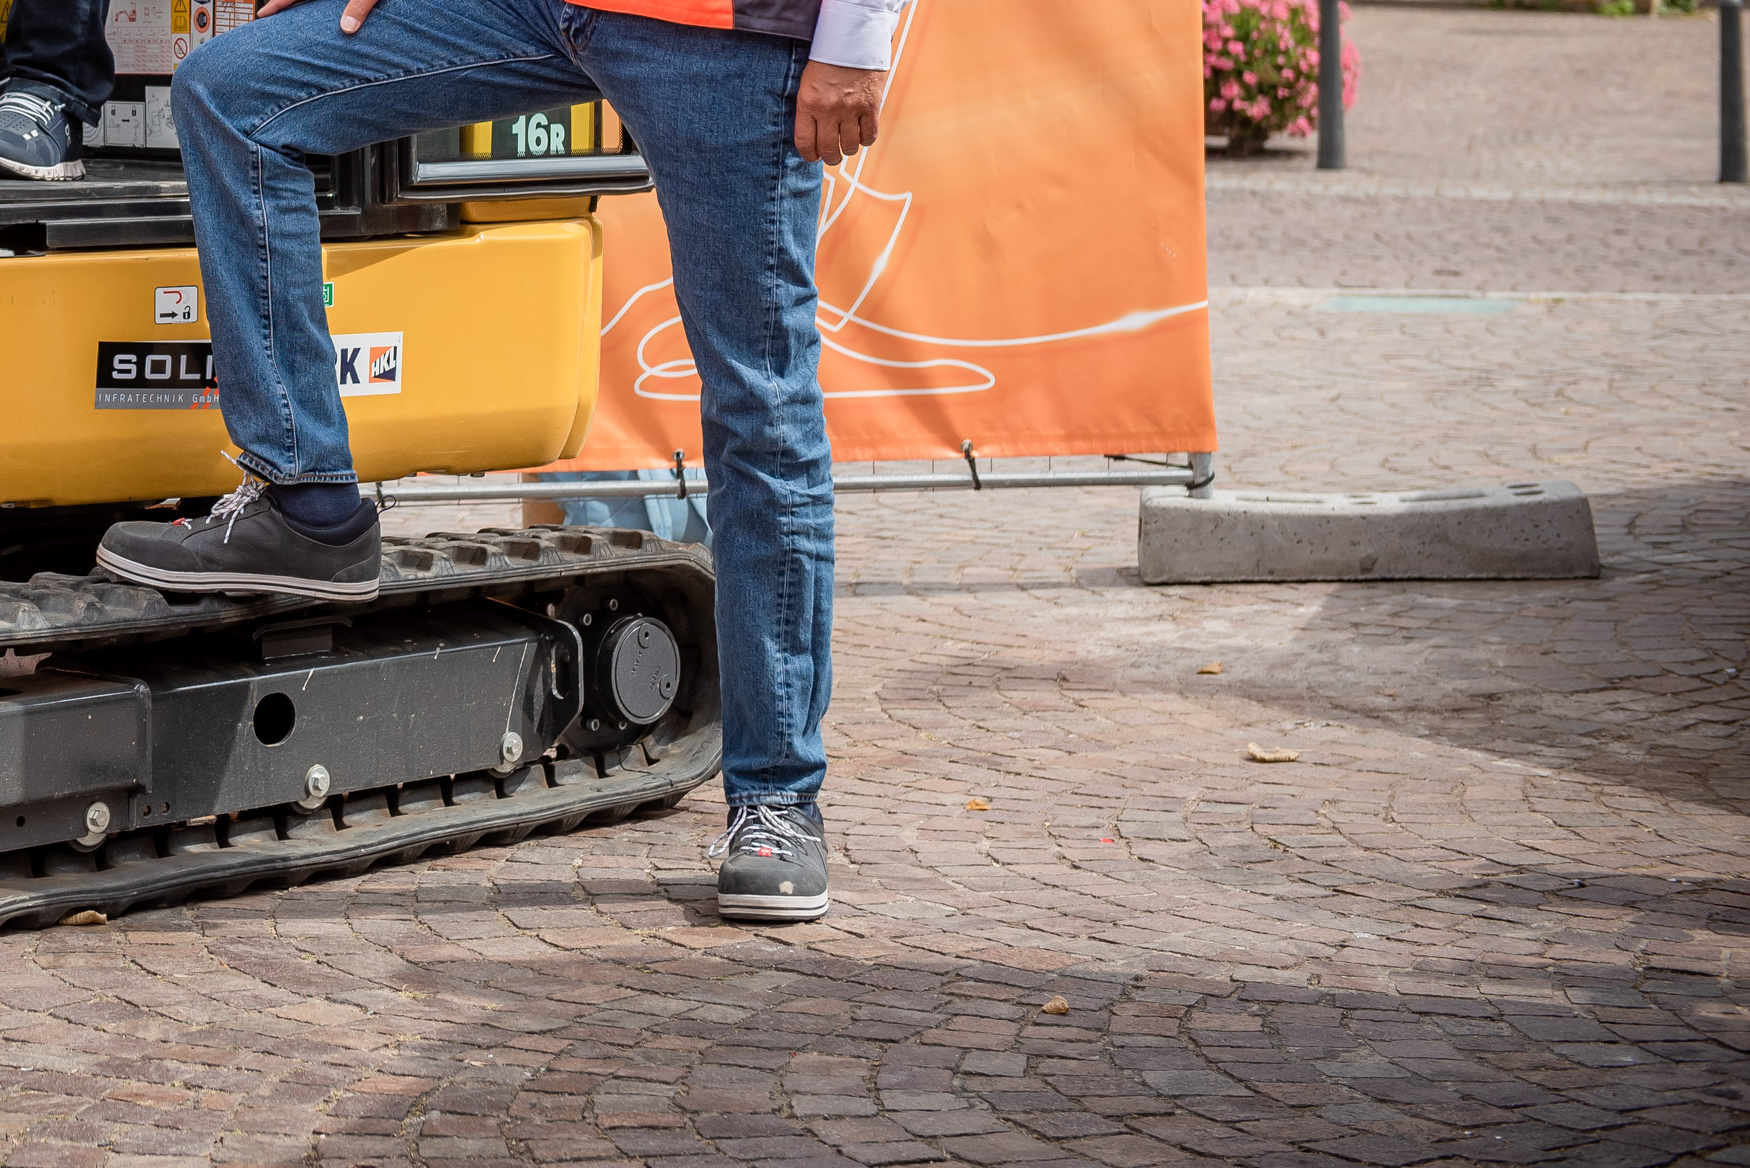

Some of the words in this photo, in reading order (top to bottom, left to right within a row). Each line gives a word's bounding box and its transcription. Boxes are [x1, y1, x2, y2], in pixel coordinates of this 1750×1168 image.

[511, 112, 566, 157] 16R
[371, 345, 397, 378] HKL
[98, 393, 185, 403] INFRATECHNIK
[192, 393, 220, 403] GmbH
